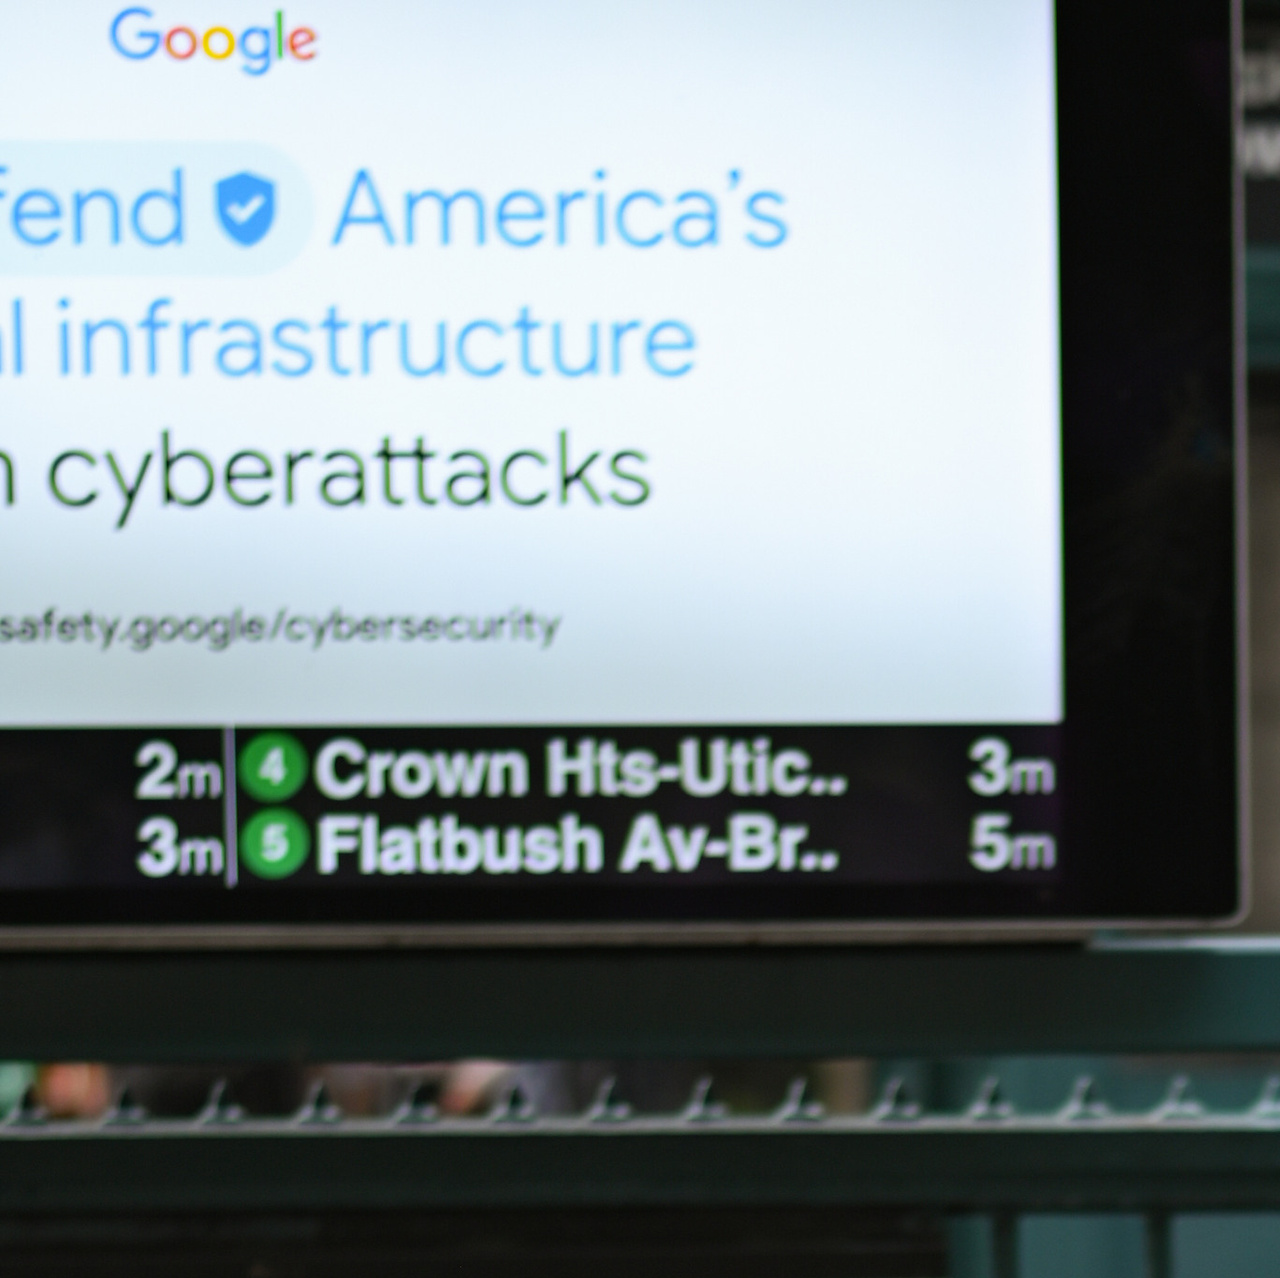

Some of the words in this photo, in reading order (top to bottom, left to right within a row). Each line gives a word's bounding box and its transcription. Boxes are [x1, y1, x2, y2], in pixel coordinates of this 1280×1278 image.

[109, 6, 317, 76] Google
[0, 165, 185, 247] end
[57, 296, 697, 378] infrastructure
[47, 429, 652, 530] cyberattacks
[0, 605, 561, 652] safety.google/cybersecurity
[136, 740, 223, 798] 2m
[258, 746, 288, 785] 4
[314, 738, 530, 799] Crown
[970, 738, 1055, 796] 3m
[137, 816, 224, 877] 3m
[259, 822, 291, 863] 5
[317, 813, 605, 876] Flatbush
[970, 814, 1056, 871] 5m
